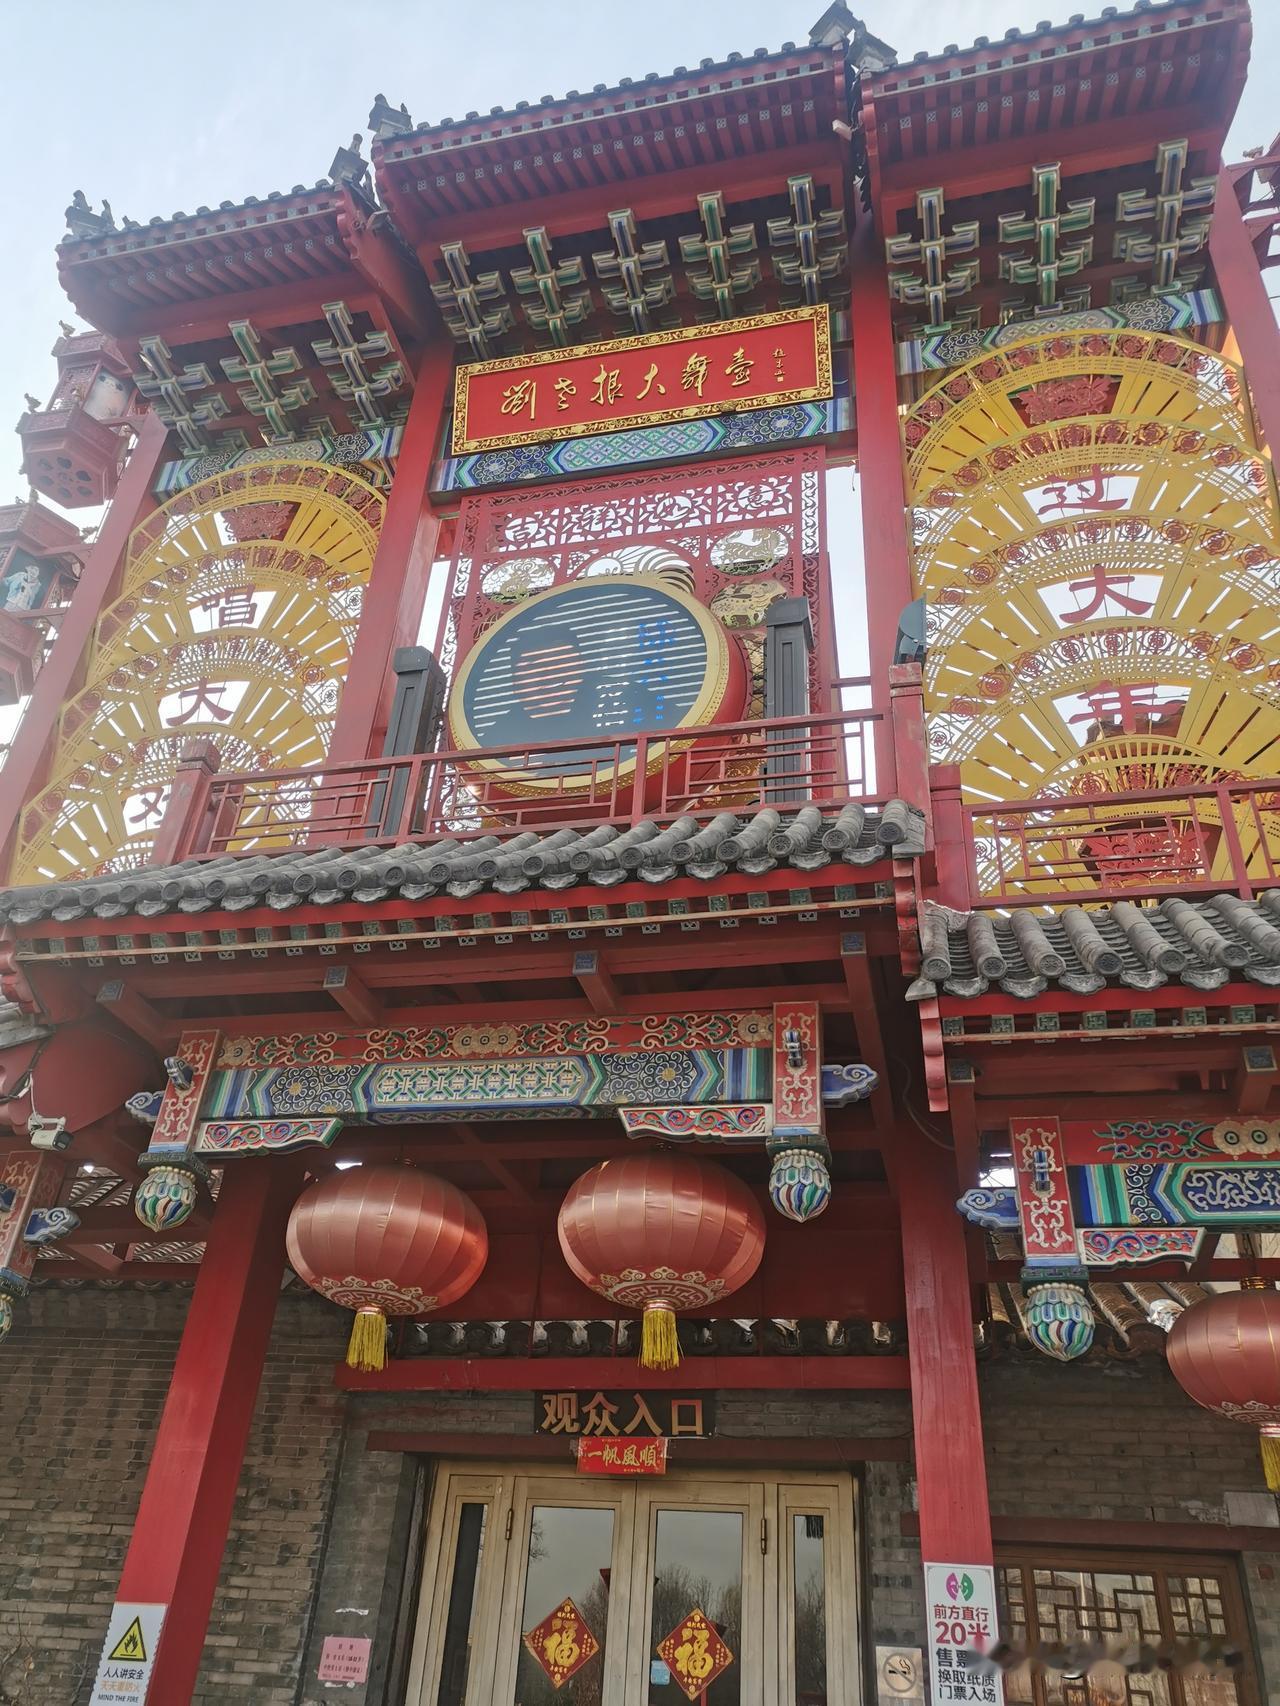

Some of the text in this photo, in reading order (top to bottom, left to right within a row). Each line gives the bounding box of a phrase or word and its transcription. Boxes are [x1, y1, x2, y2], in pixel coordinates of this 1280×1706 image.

[1038, 464, 1177, 733] 过大年
[540, 1391, 704, 1437] 观众入口
[934, 1603, 989, 1622] 前方直行
[543, 1618, 580, 1667] 福
[935, 1620, 991, 1648] 20米
[674, 1627, 714, 1678] 福
[103, 1666, 144, 1680] 人人讲安全
[938, 1668, 996, 1688] 换取纸质
[98, 1693, 114, 1702] MIND
[939, 1684, 996, 1703] 门票入场
